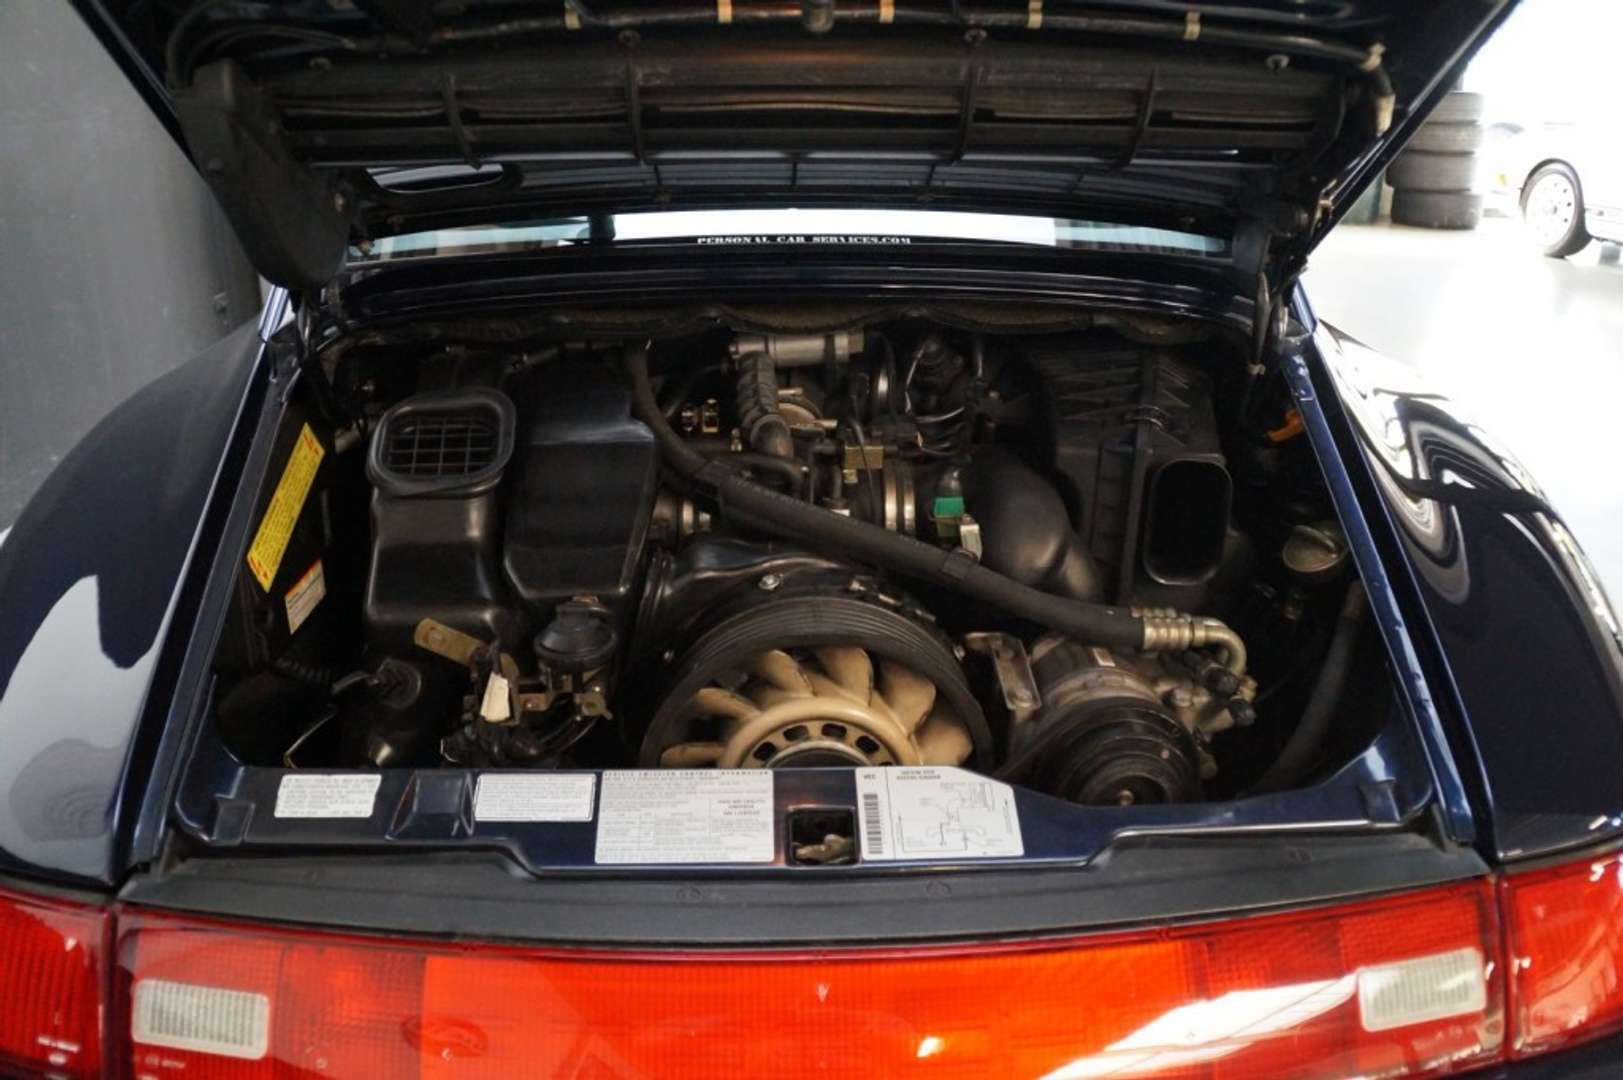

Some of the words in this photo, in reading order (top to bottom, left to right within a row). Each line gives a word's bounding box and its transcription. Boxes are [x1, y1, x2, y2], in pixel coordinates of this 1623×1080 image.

[696, 236, 770, 245] PERSONAL
[776, 236, 806, 244] CAR
[812, 236, 912, 245] SERVICES.COM
